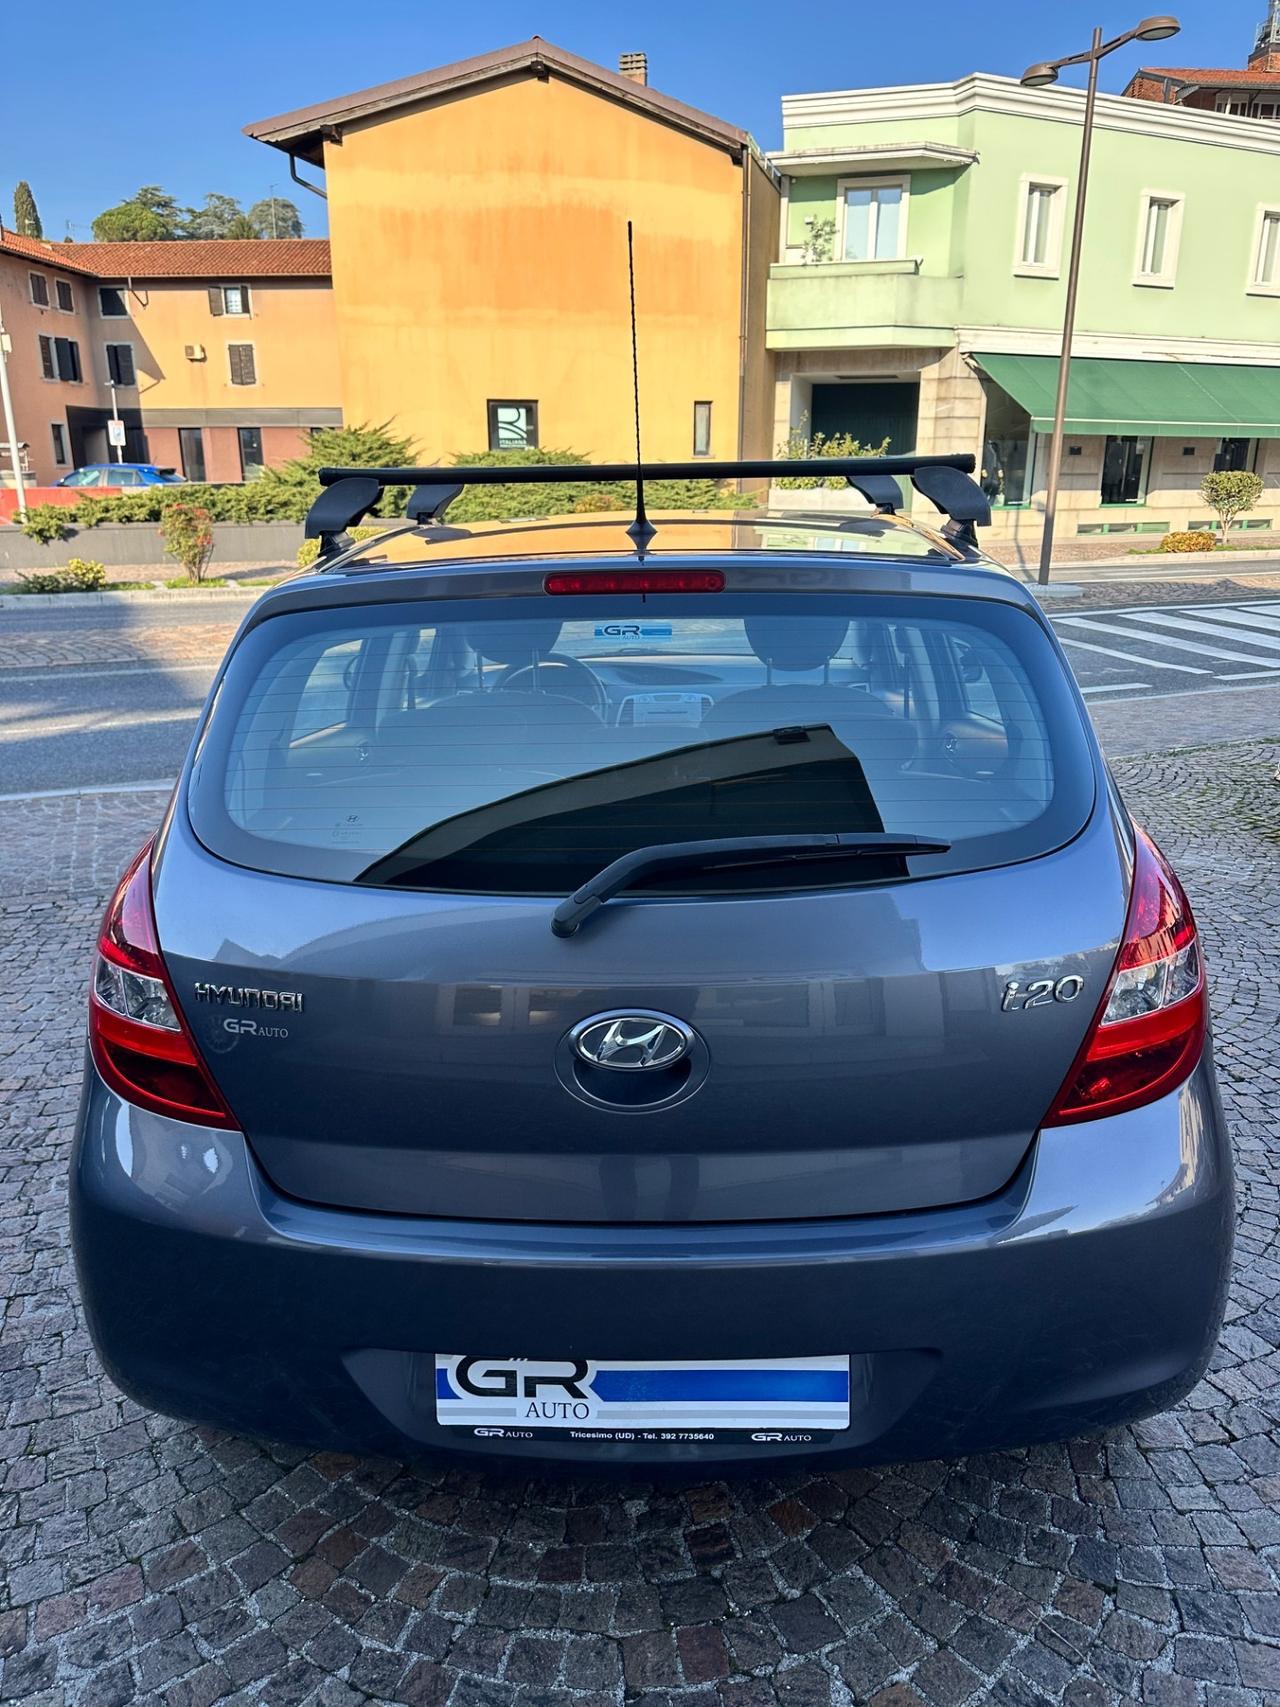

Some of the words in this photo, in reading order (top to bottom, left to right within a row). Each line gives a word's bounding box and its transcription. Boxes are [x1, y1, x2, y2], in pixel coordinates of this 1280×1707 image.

[604, 625, 640, 635] GR
[194, 982, 304, 1012] HYUNDAI
[1001, 974, 1085, 1012] i20
[223, 1018, 257, 1035] GR
[258, 1027, 289, 1039] AUTO
[456, 1355, 589, 1399] GR
[525, 1402, 590, 1420] AUTO
[473, 1427, 505, 1438] GR
[505, 1431, 534, 1439] AUTO
[570, 1431, 613, 1439] Tricesimo
[615, 1432, 635, 1440] (UD)
[751, 1432, 783, 1441] GR
